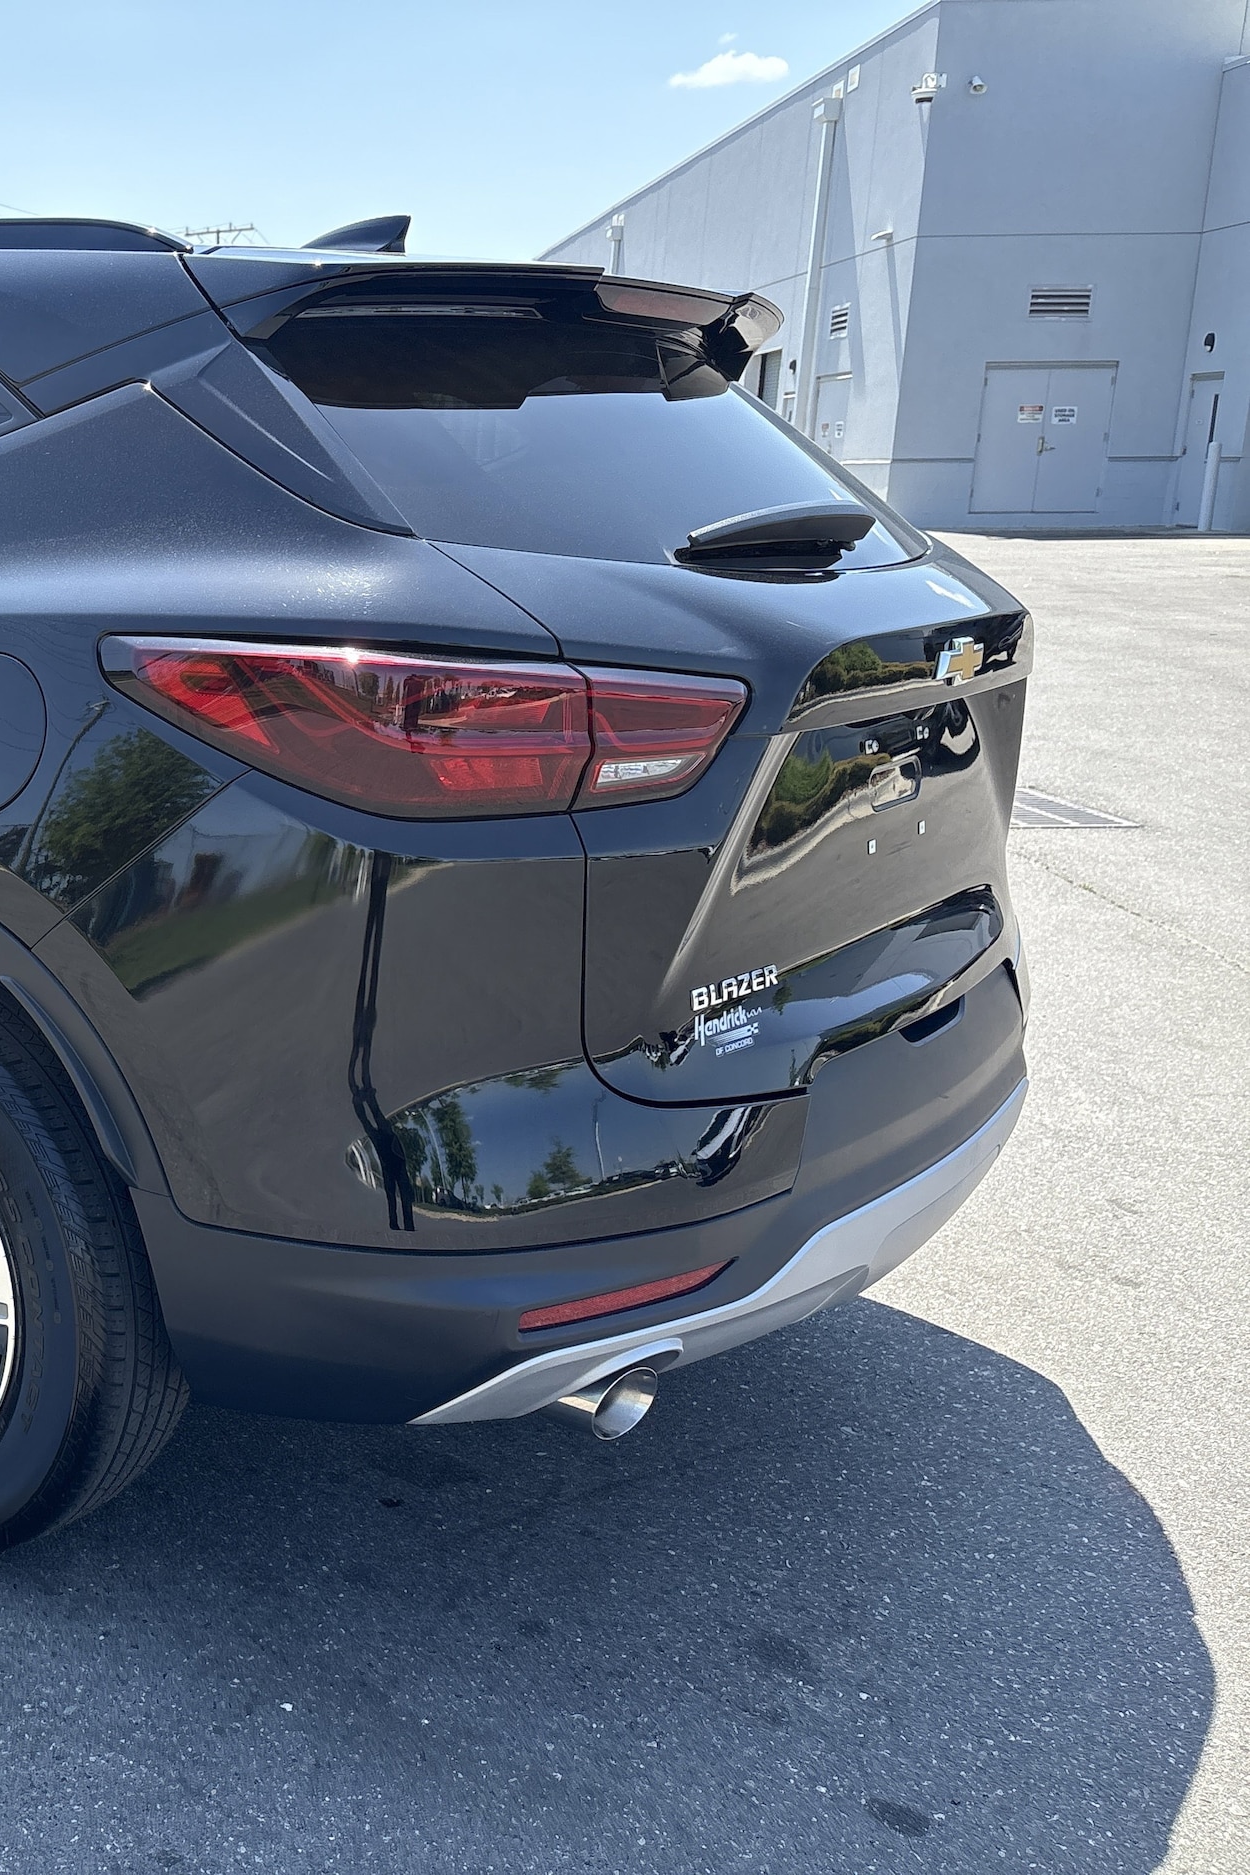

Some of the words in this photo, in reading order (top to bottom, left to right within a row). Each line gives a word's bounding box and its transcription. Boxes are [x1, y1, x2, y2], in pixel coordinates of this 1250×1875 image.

[690, 964, 779, 1012] BLAZER
[694, 1004, 748, 1047] Hendrick
[716, 1046, 724, 1056] OF
[724, 1037, 754, 1053] CONCORD
[19, 1235, 45, 1435] CONTACT
